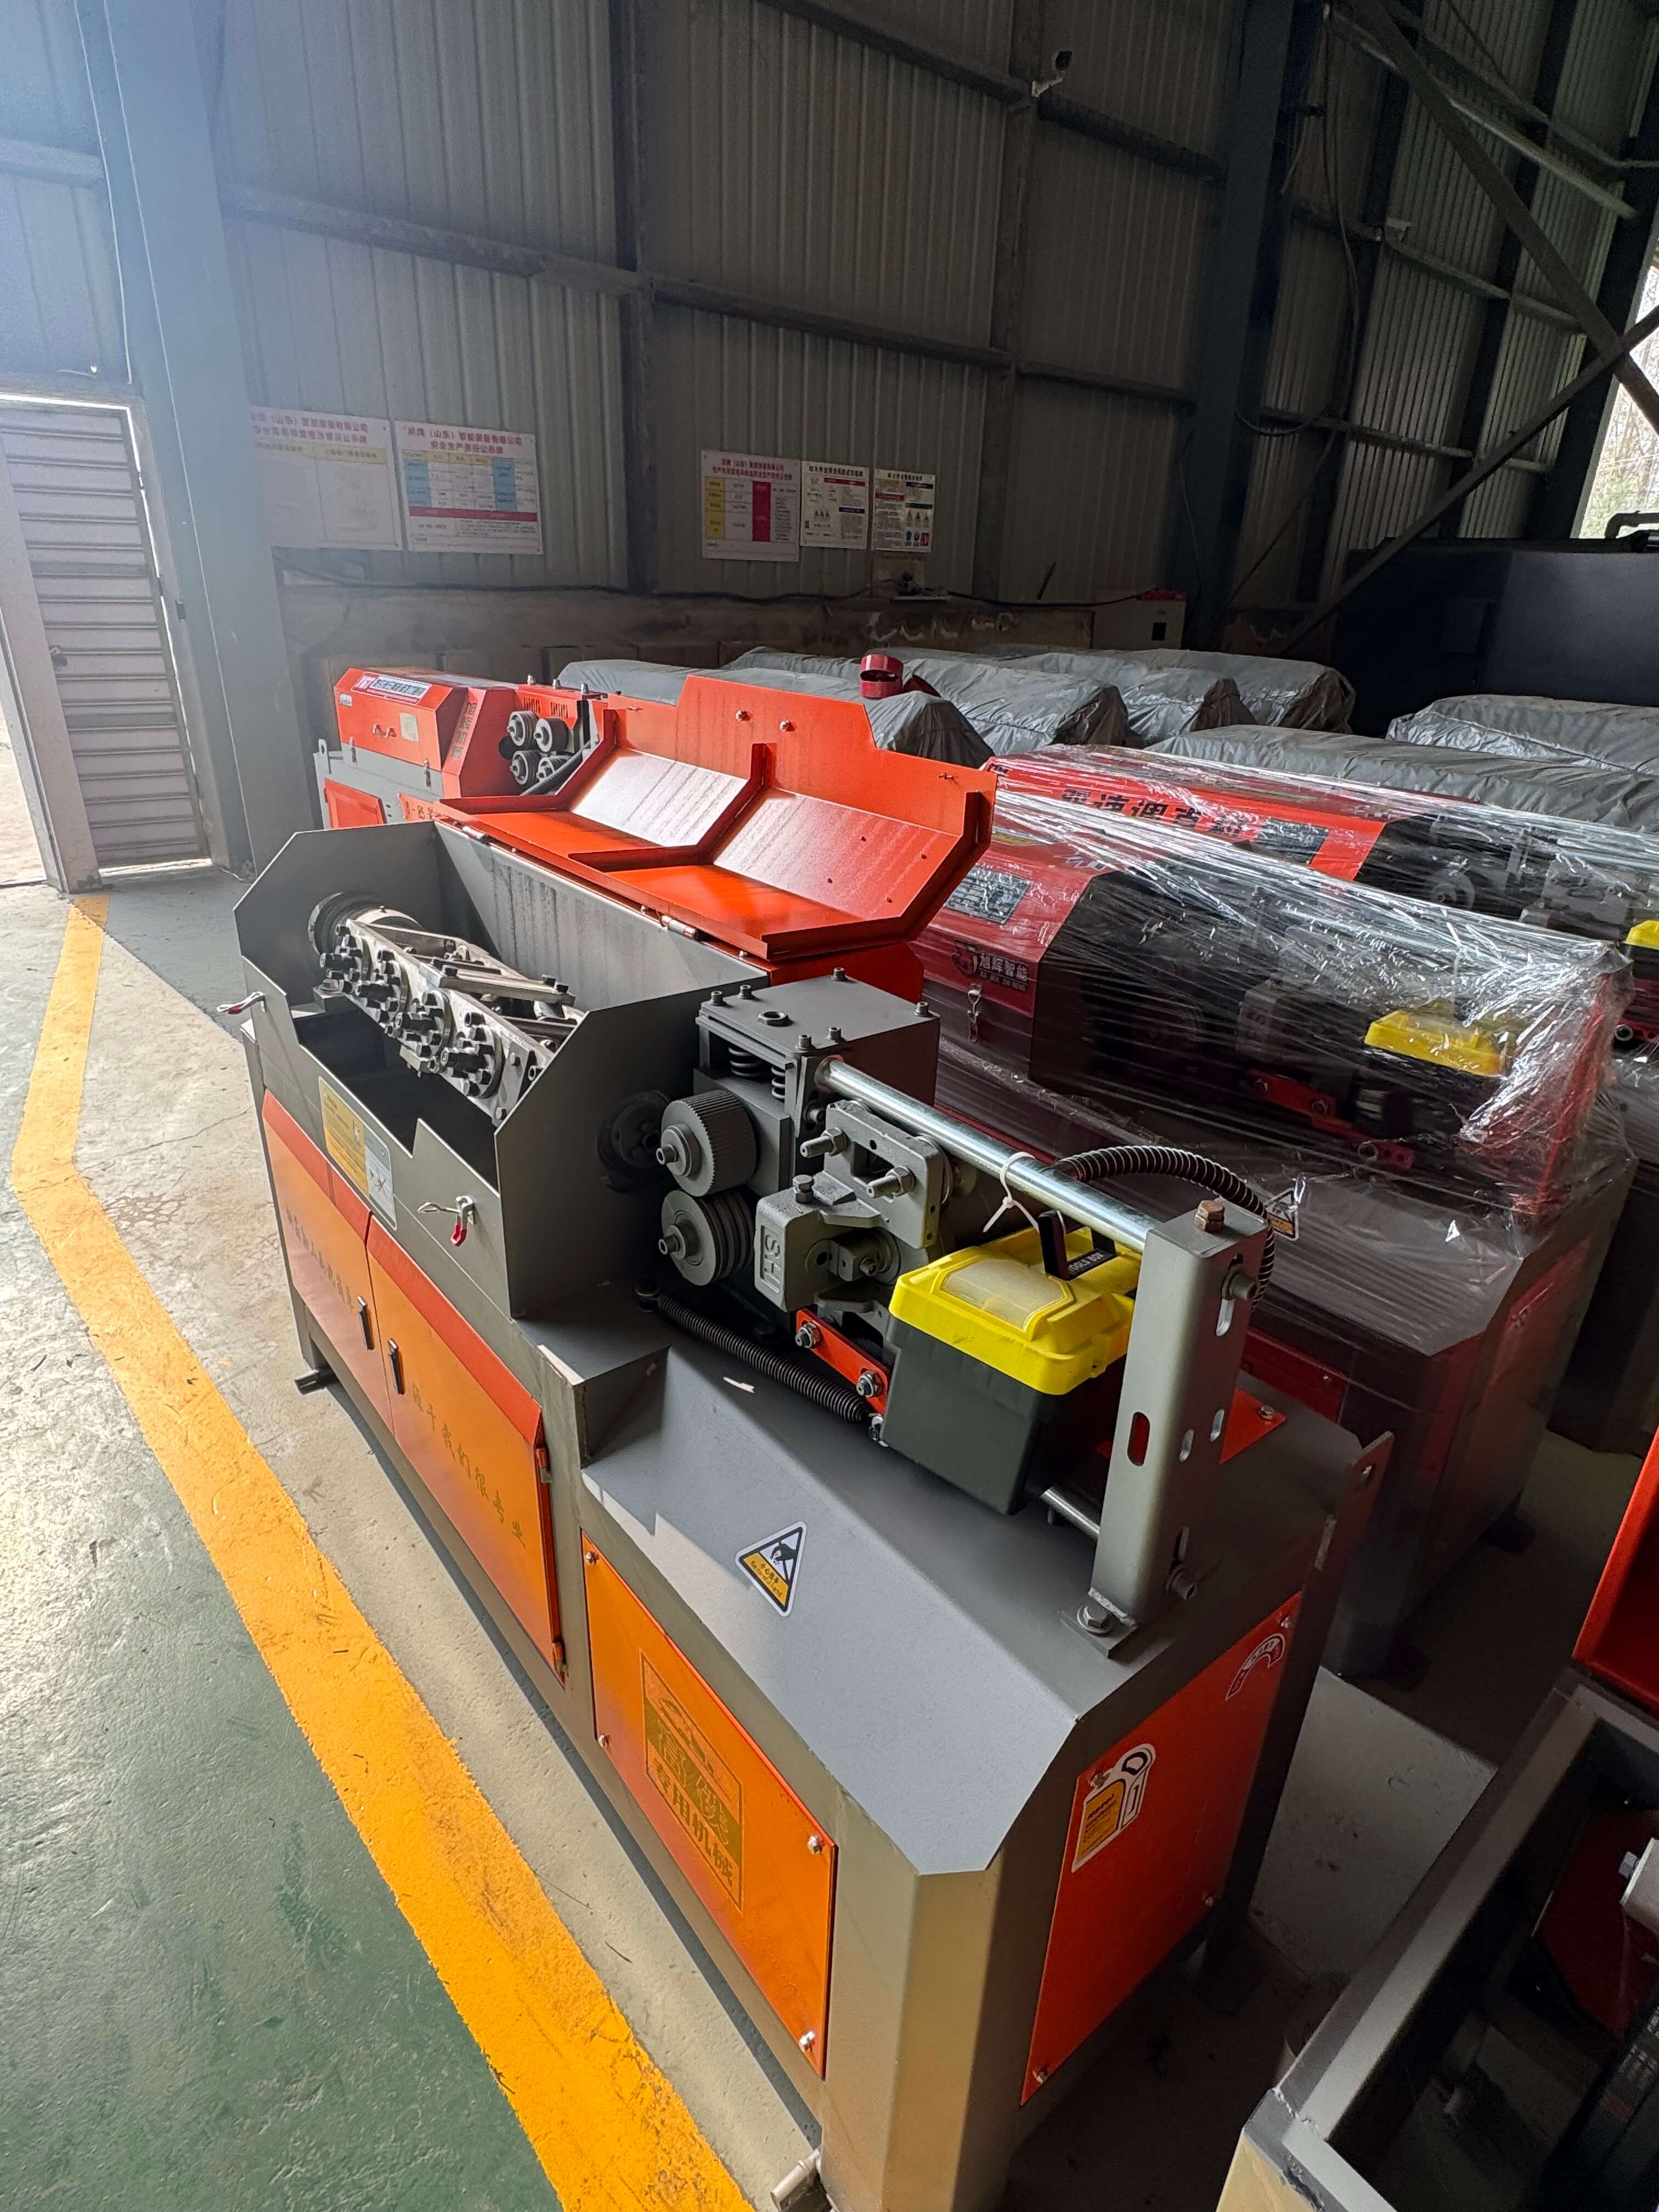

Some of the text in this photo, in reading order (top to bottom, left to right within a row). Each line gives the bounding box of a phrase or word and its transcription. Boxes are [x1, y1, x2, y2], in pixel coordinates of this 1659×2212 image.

[979, 953, 1028, 981] 旭辉智能
[1087, 1252, 1105, 1262] BOX
[657, 1718, 730, 1846] 高铁
[653, 1756, 734, 1889] 专用机械
